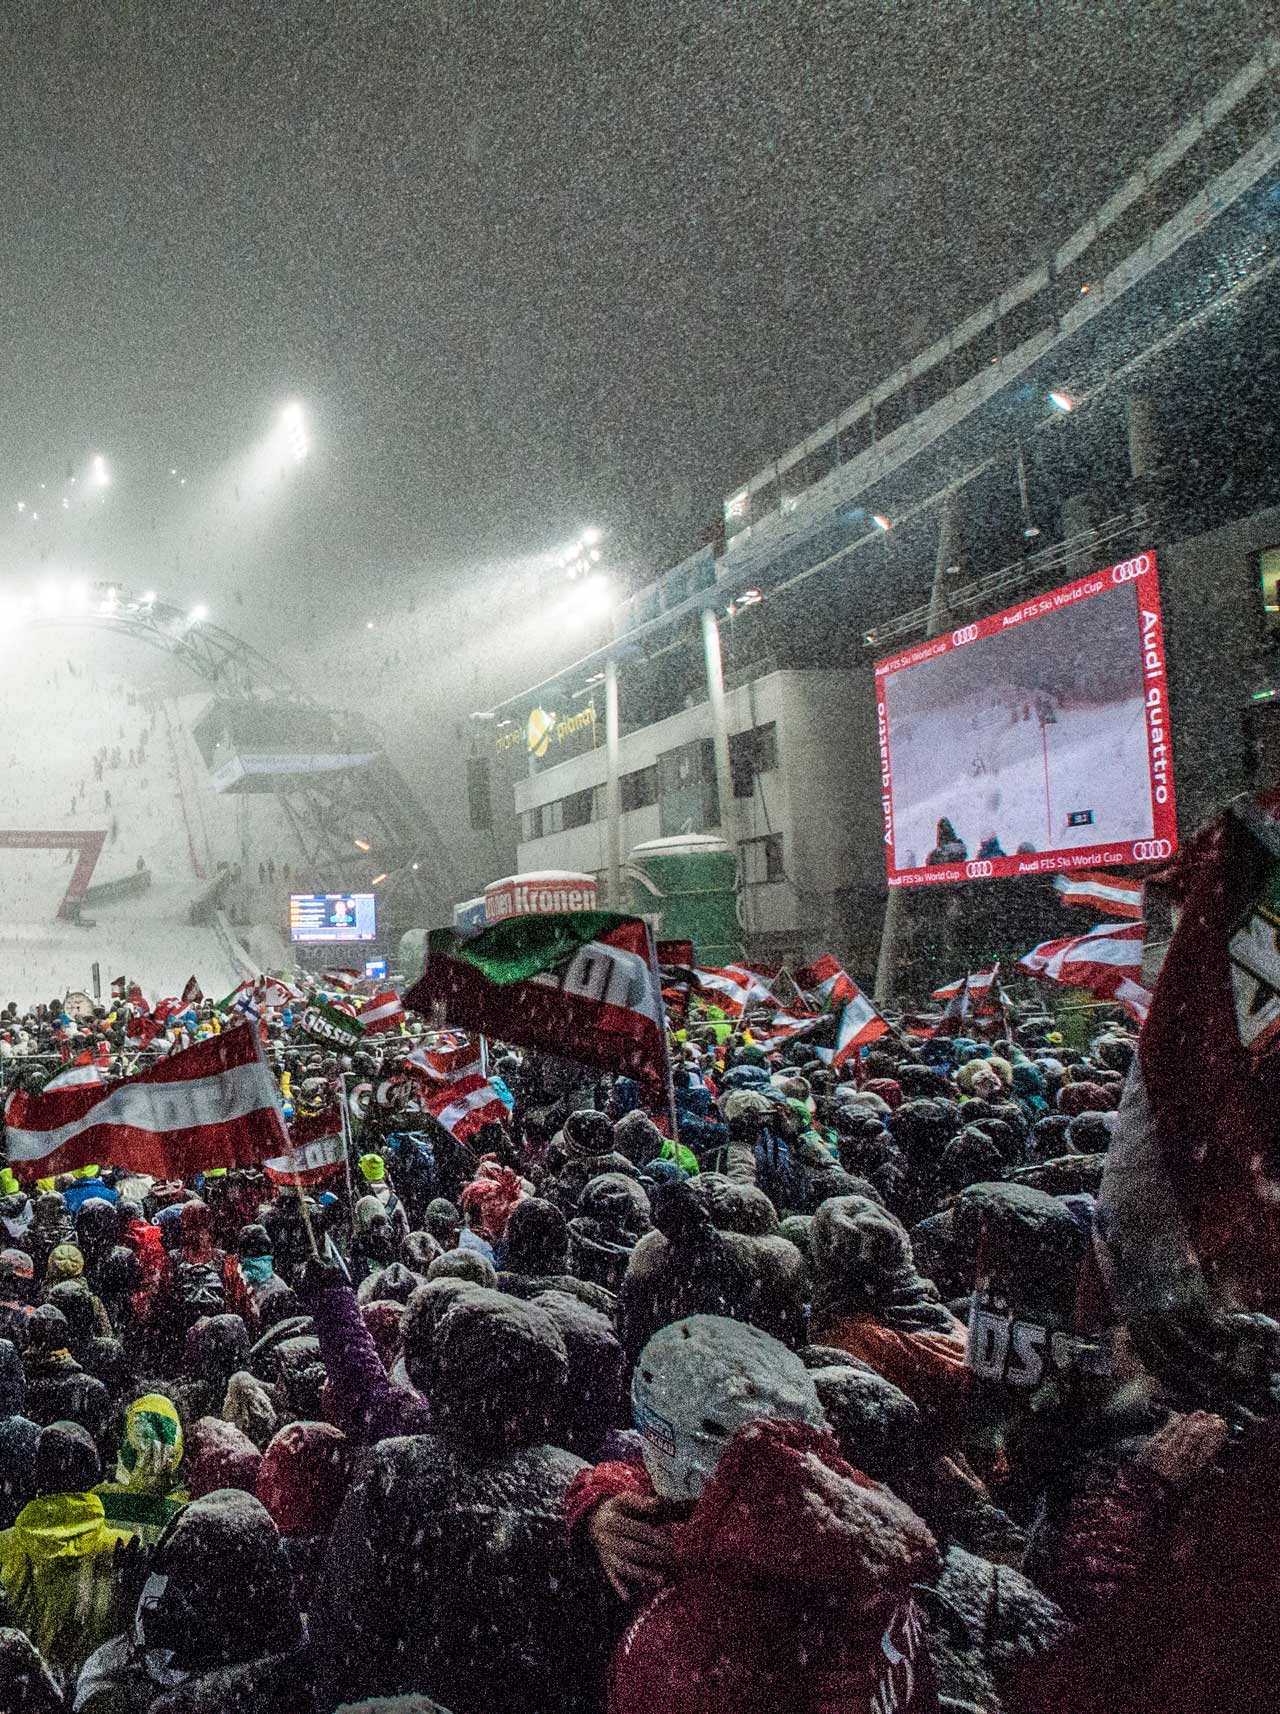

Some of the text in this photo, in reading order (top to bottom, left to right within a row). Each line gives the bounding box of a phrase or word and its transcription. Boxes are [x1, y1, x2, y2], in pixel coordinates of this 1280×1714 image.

[1002, 581, 1104, 626] Audi FIS Ski World Cup
[912, 647, 933, 662] World
[932, 643, 947, 655] Cup
[1141, 610, 1168, 805] Audi quattro
[877, 702, 893, 846] Audi quattro
[925, 871, 945, 881] World
[946, 869, 960, 880] Cup
[1018, 851, 1123, 872] Audi FIS Ski World Cup
[513, 886, 597, 914] Kronen
